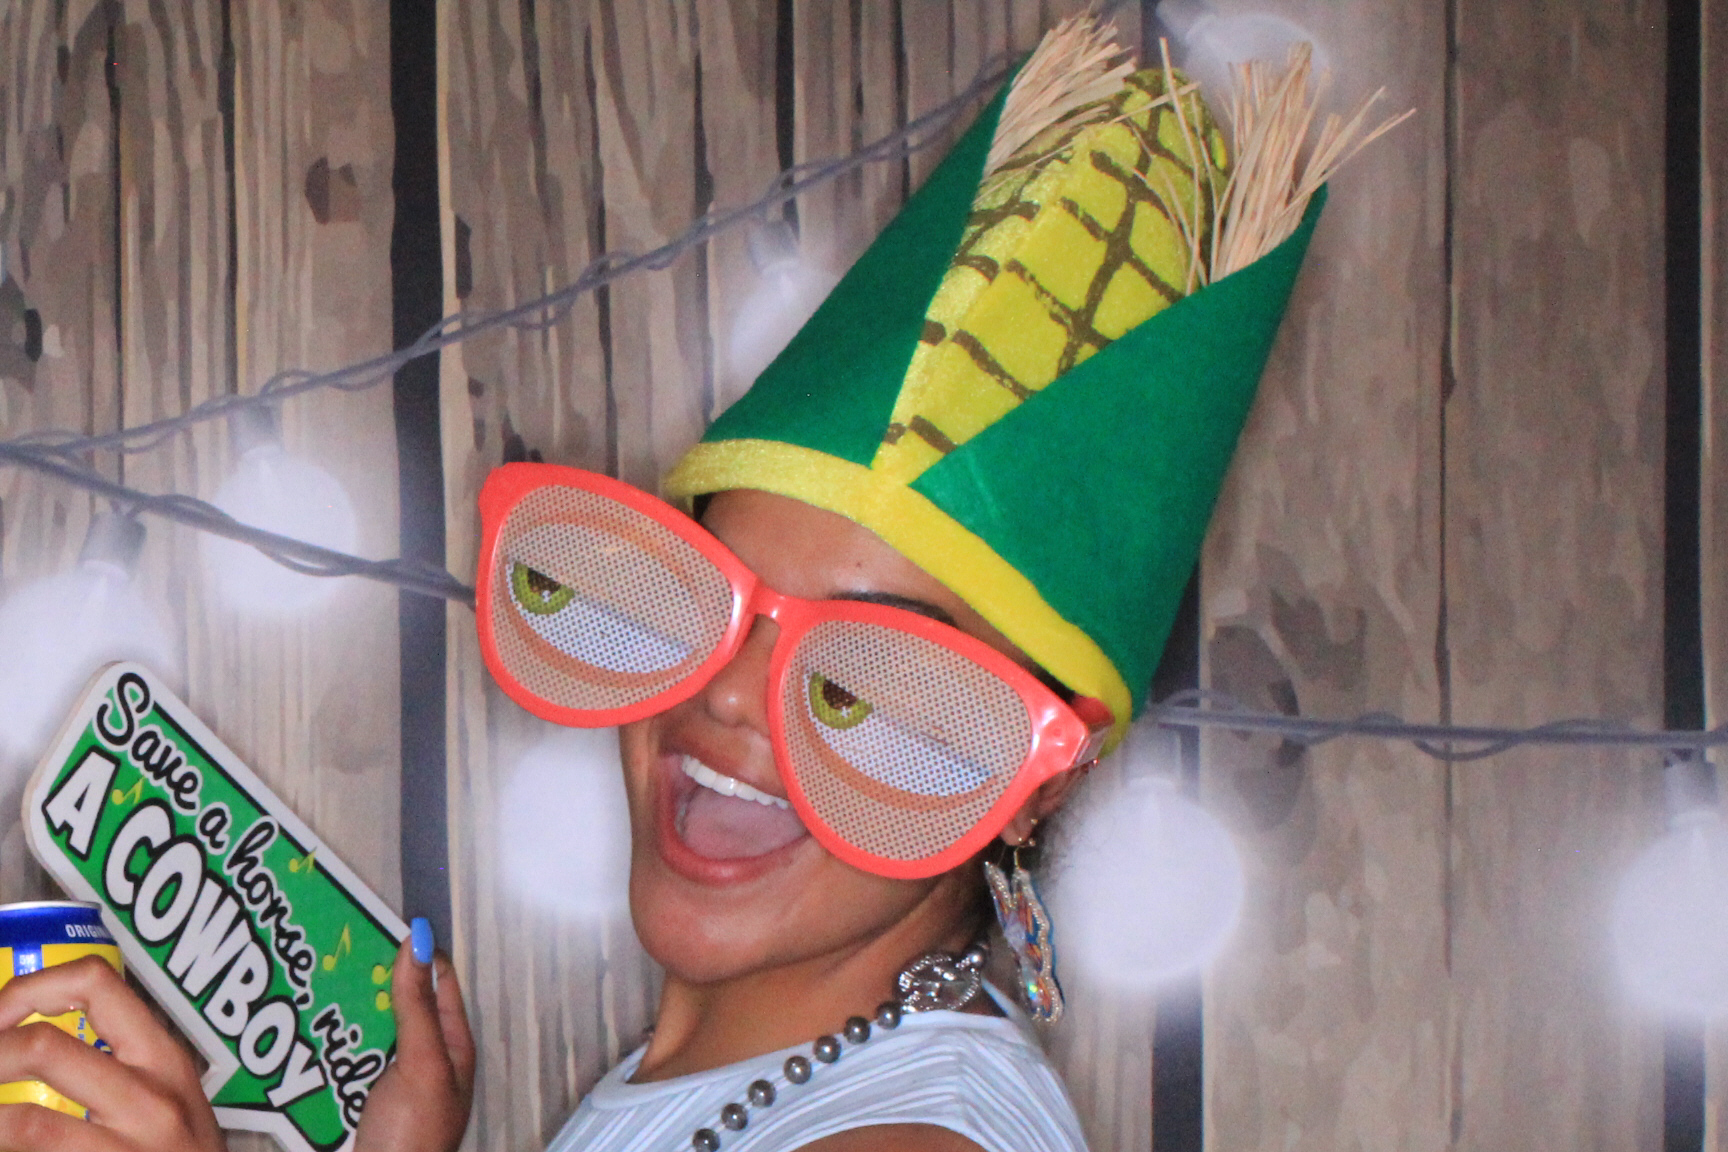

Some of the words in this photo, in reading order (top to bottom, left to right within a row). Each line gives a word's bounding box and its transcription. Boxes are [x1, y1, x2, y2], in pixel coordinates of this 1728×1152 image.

[41, 745, 121, 861] A
[102, 798, 327, 1108] COWBOY
[95, 672, 199, 812] Save
[198, 807, 228, 850] a
[224, 818, 313, 1007] horse,
[313, 1007, 382, 1130] ride
